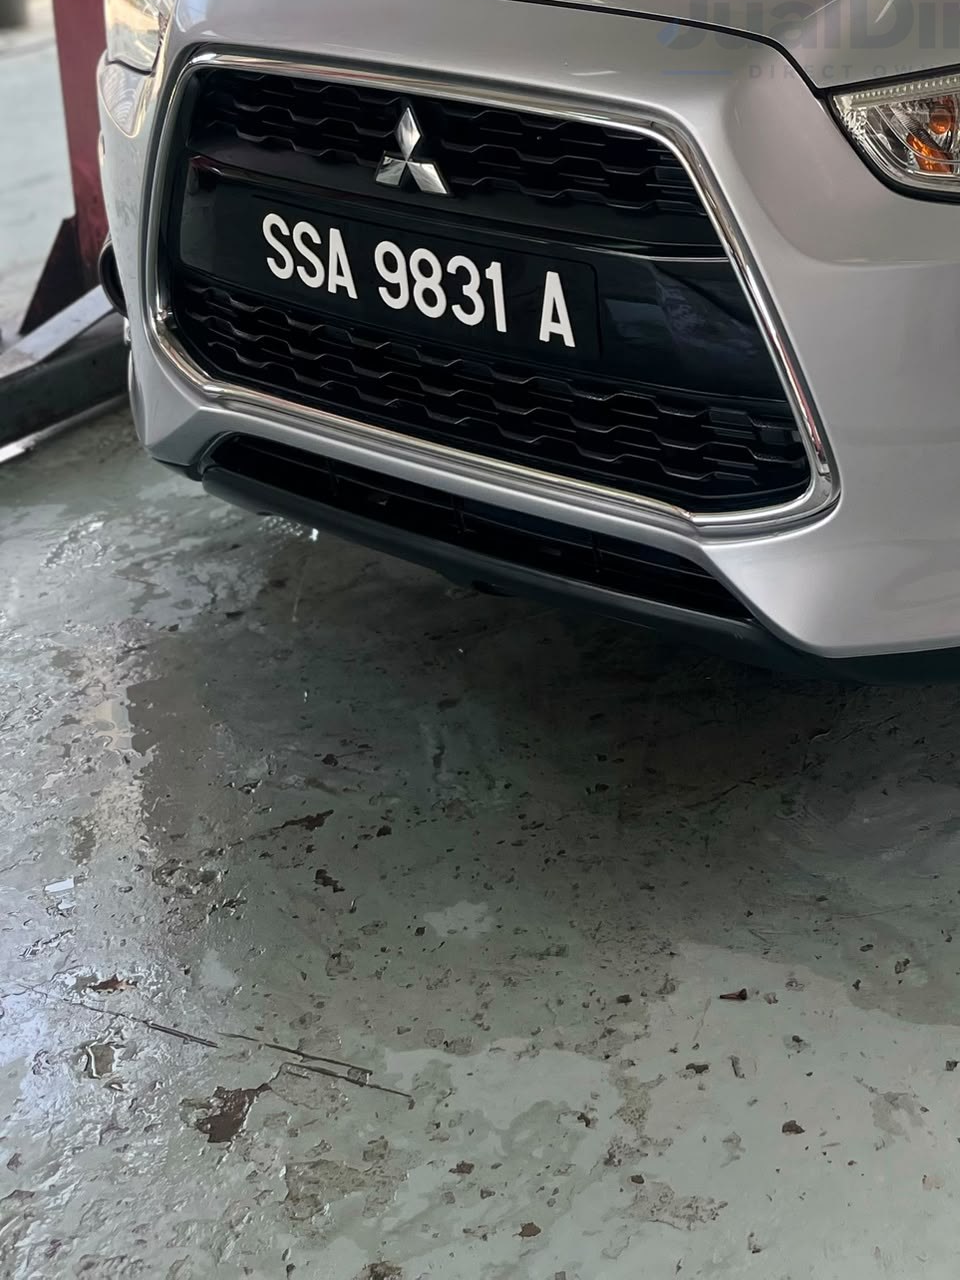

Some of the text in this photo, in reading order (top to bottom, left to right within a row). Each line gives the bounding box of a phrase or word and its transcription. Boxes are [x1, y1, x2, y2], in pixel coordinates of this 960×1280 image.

[262, 213, 575, 348] SSA 9831 A
